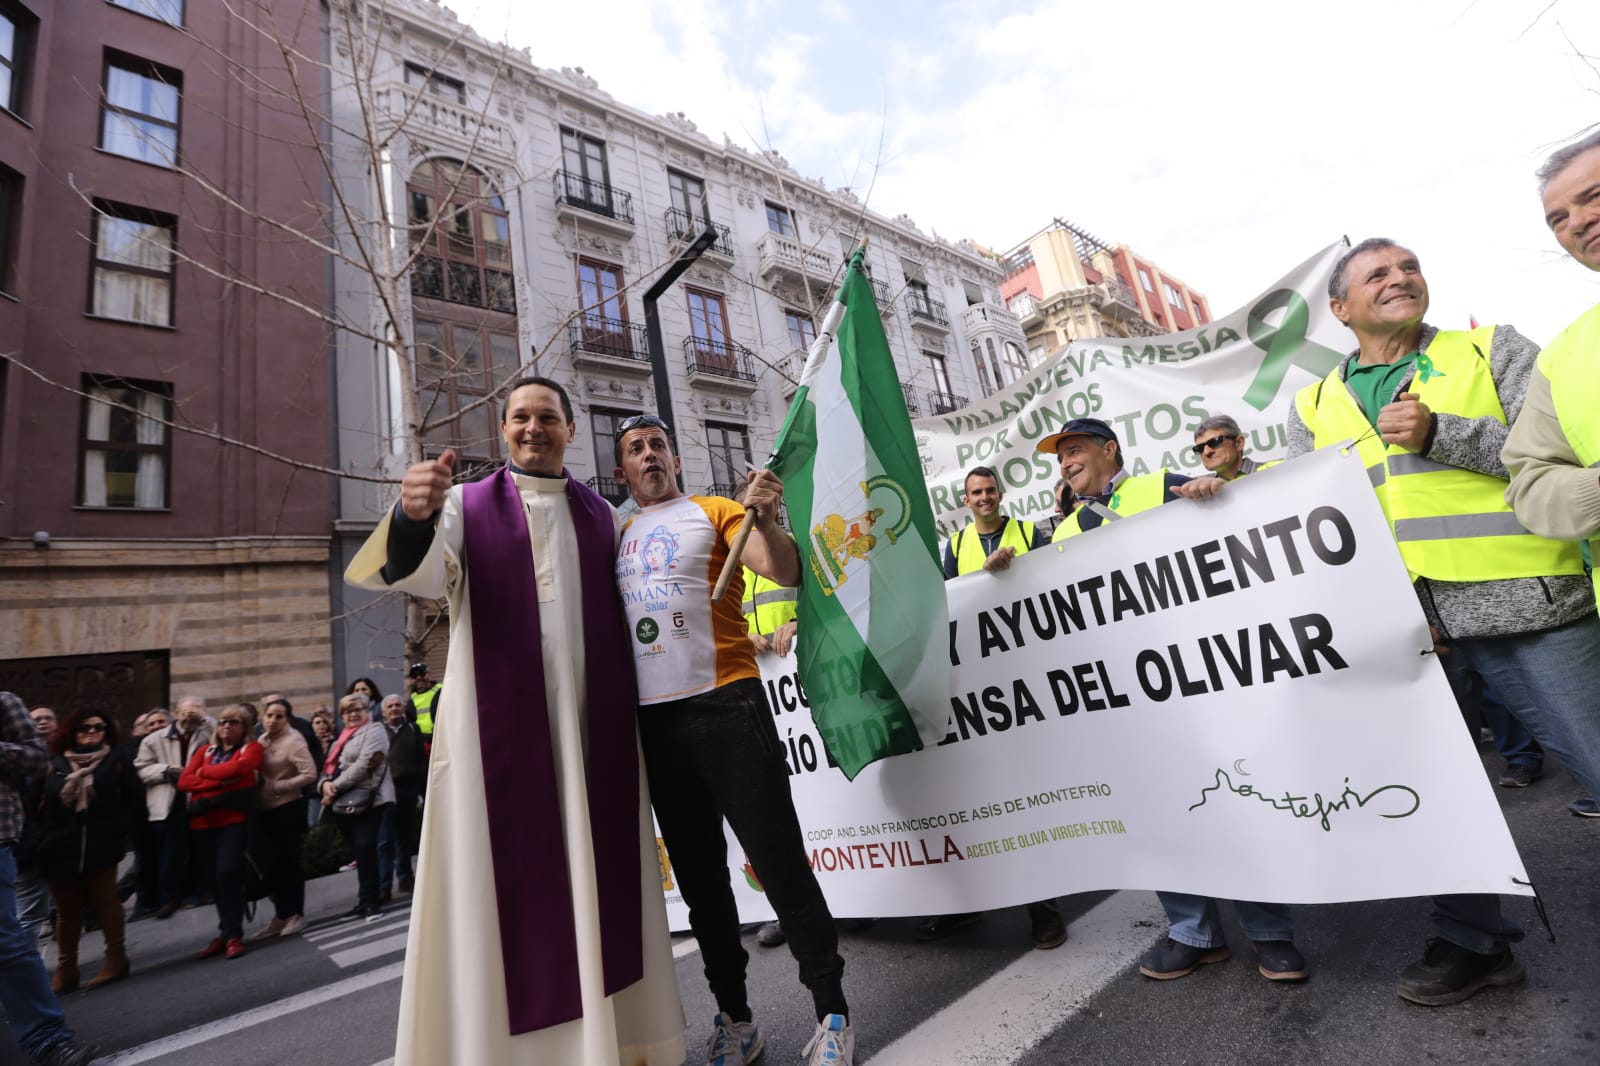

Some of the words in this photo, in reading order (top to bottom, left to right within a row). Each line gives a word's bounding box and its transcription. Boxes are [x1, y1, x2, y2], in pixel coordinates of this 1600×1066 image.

[943, 348, 1110, 436] VILLANUEVA
[1122, 325, 1242, 369] MESÍA
[956, 430, 1013, 469] POR
[1017, 382, 1104, 440] UNOS
[980, 505, 1357, 658] AYUNTAMIENTO
[1047, 660, 1130, 716] DEL
[1135, 612, 1350, 703] OLIVAR
[860, 824, 881, 837] SAN
[882, 815, 947, 834] FRANCISCO
[949, 811, 969, 825] DE
[972, 802, 1003, 821] ASÍS
[1004, 798, 1025, 814] DE
[1026, 781, 1112, 808] MONTEFRÍO
[966, 840, 1001, 859] ACEITE
[1002, 837, 1017, 852] DE
[1017, 830, 1049, 849] OLIVA
[1049, 819, 1127, 841] VIRGEN-EXTRA
